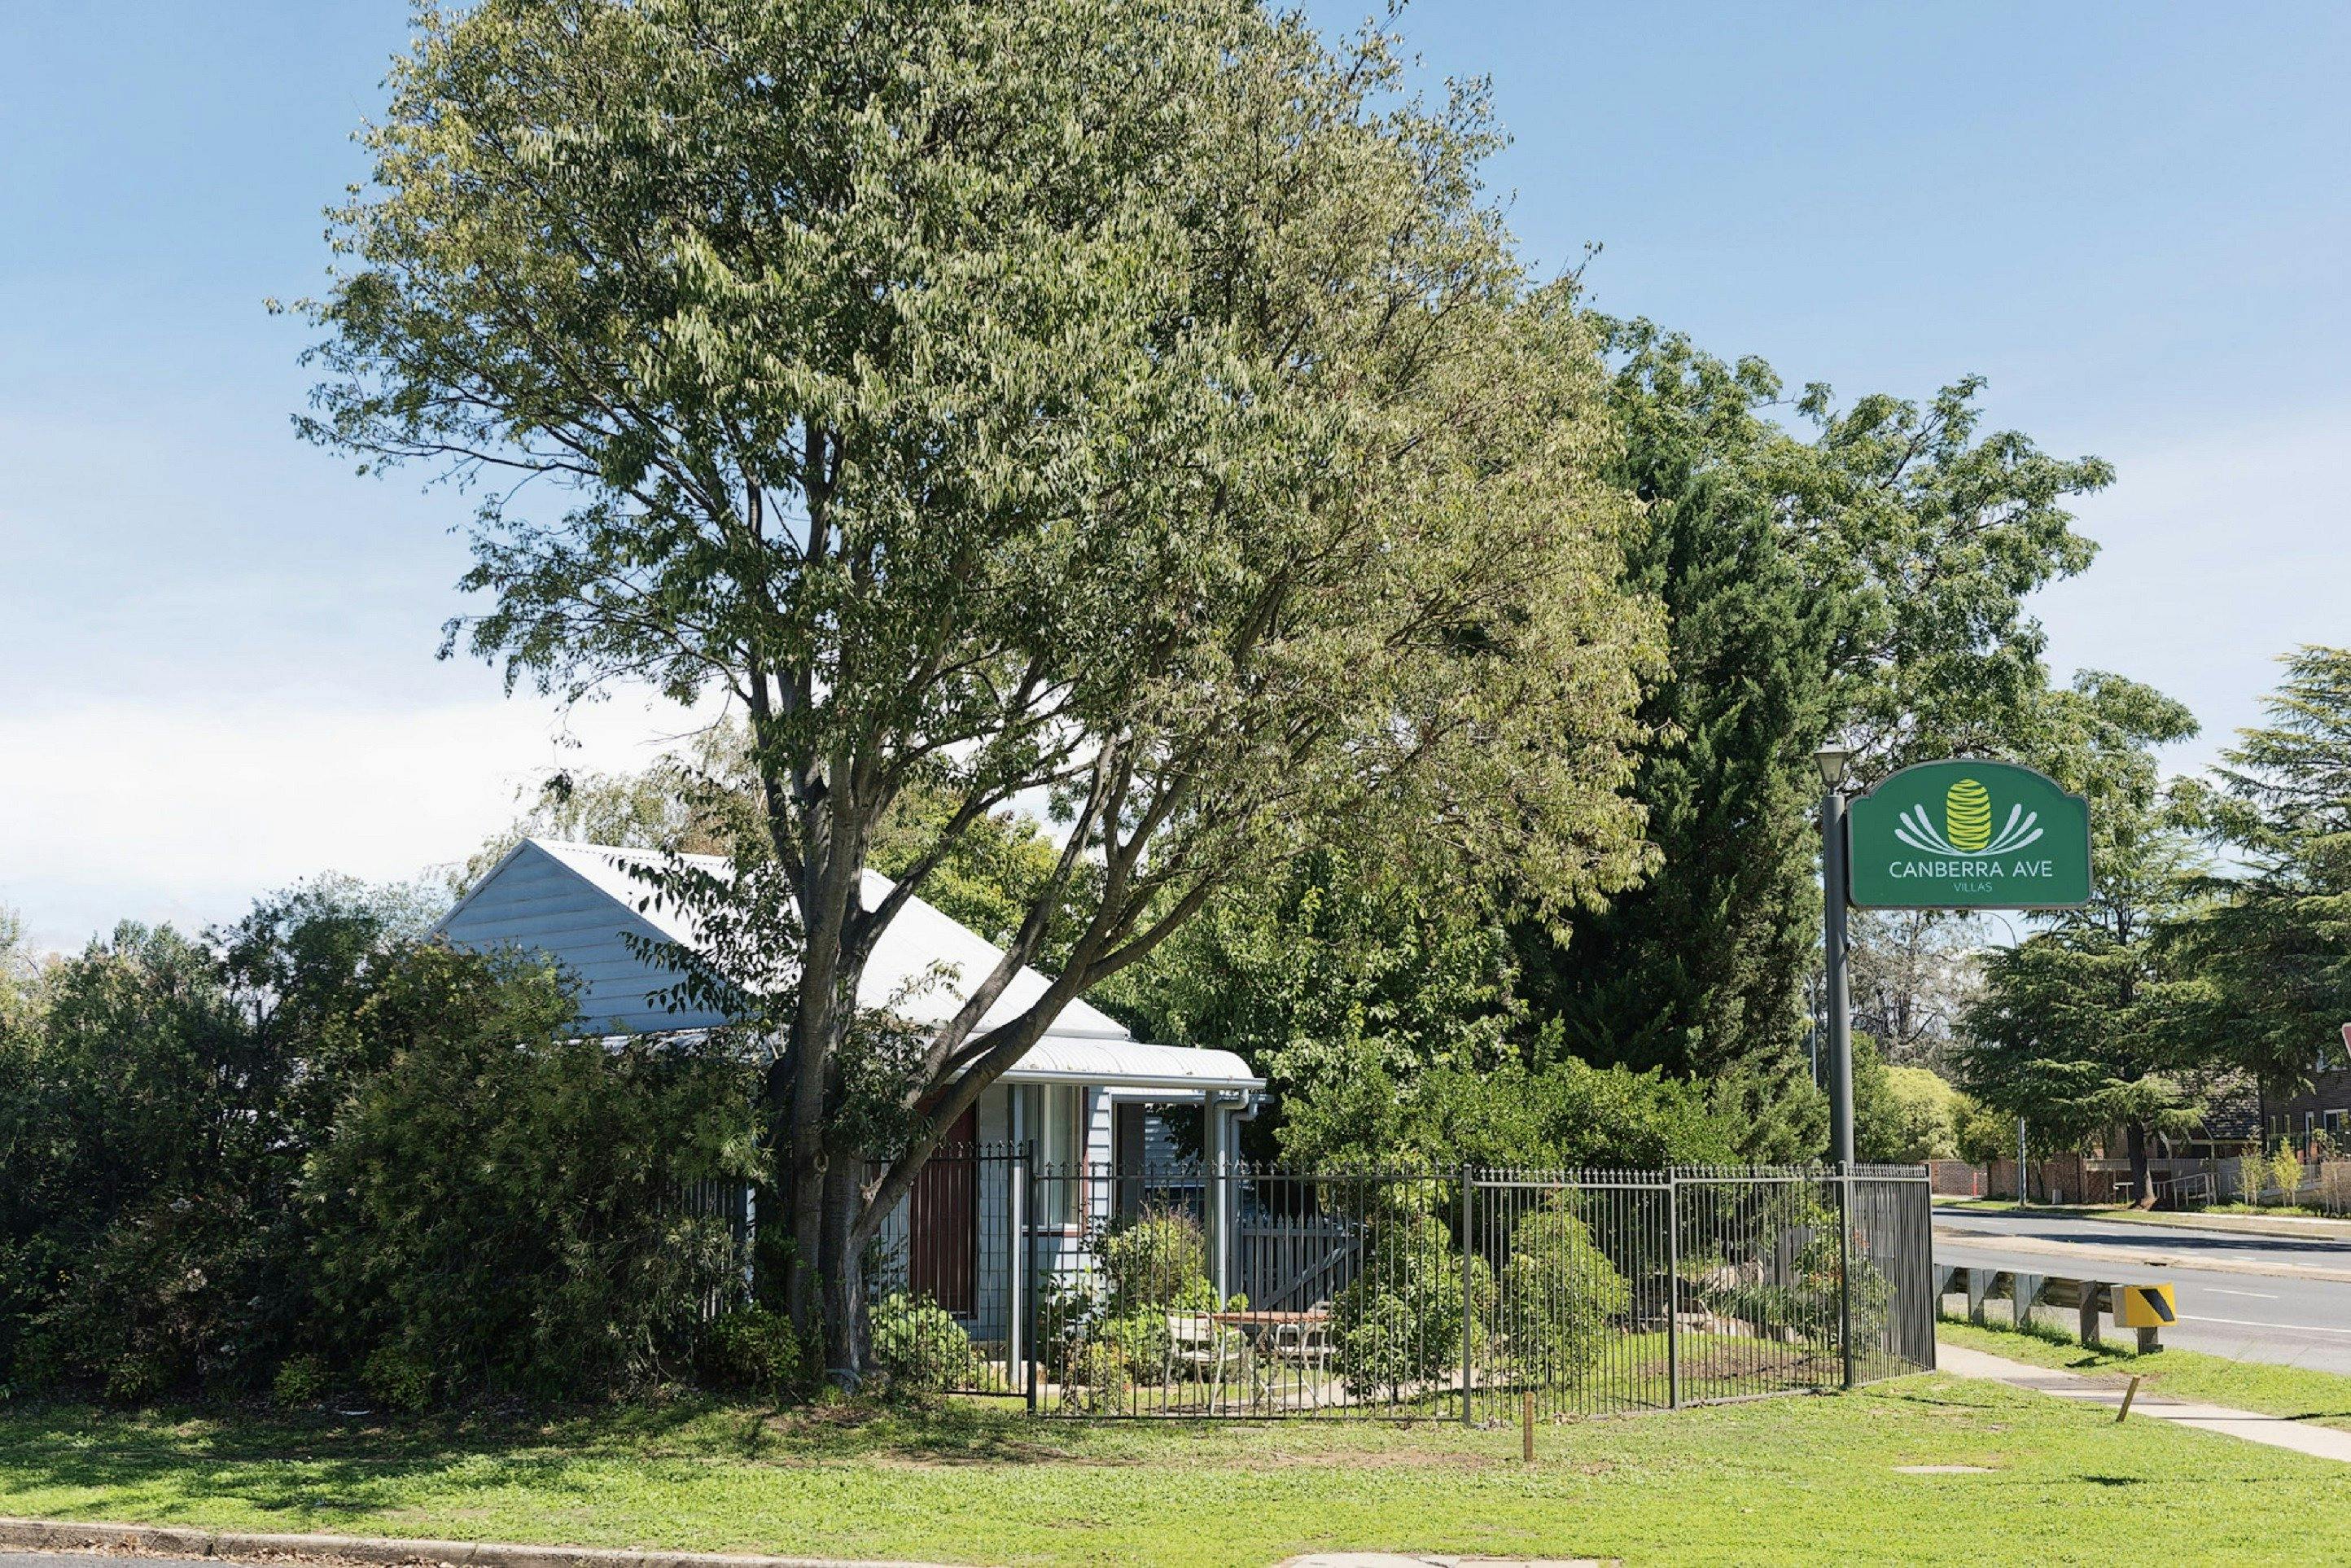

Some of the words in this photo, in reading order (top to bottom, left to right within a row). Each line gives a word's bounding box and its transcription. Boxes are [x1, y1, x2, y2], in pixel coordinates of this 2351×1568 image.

[1889, 861, 2003, 878] CANBERRA
[2012, 860, 2053, 878] AVE
[1953, 882, 1993, 893] VILLAS
